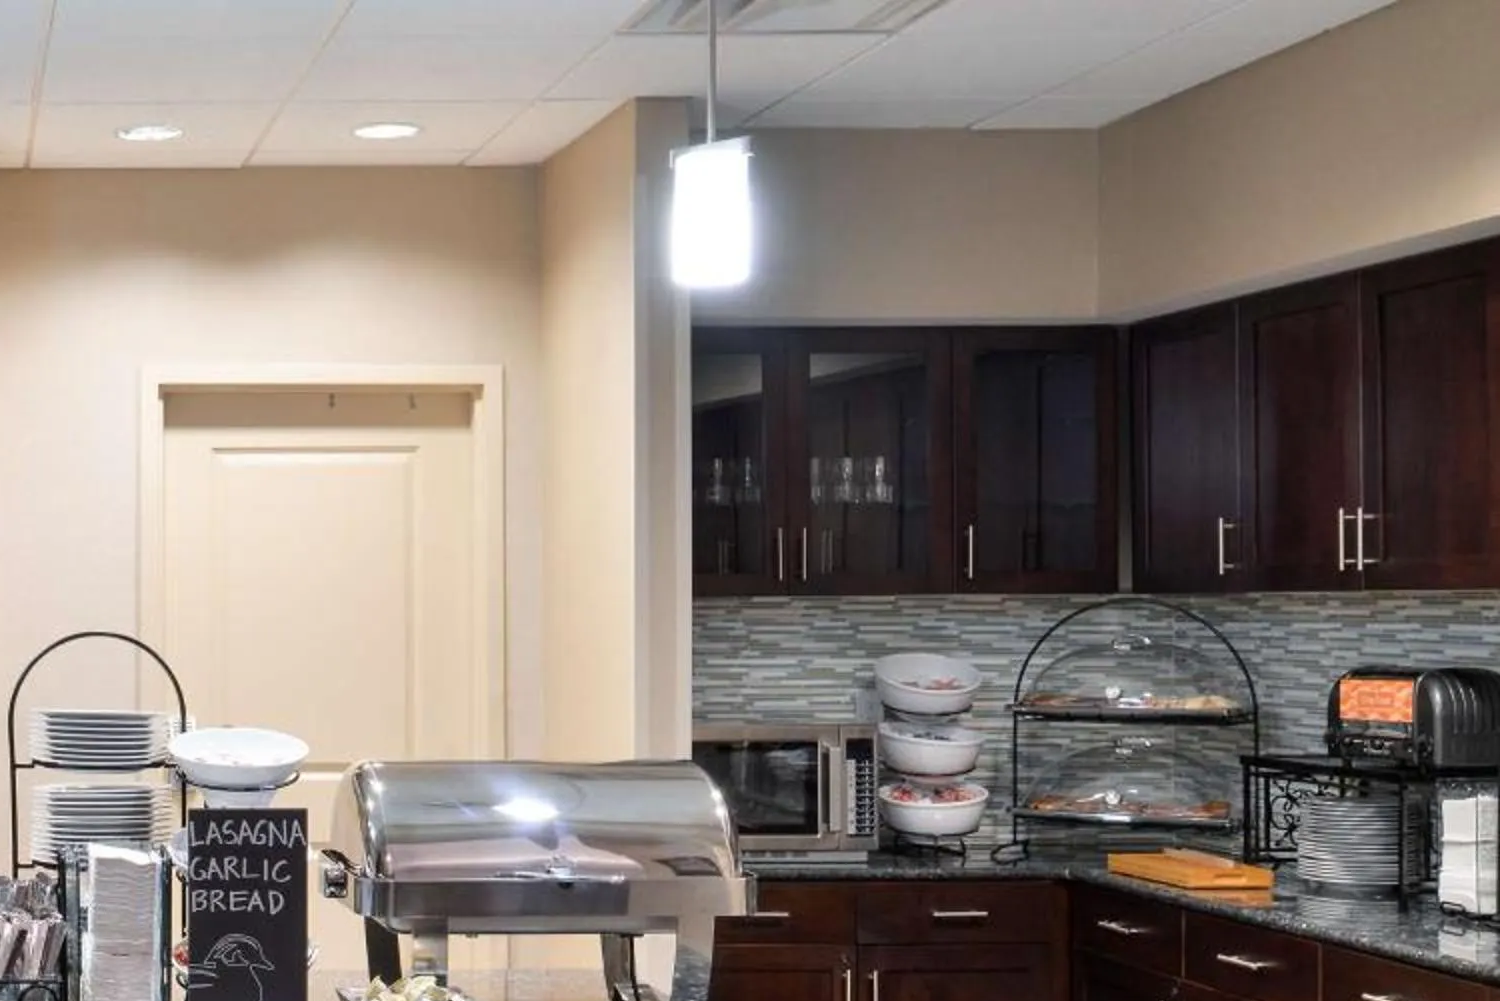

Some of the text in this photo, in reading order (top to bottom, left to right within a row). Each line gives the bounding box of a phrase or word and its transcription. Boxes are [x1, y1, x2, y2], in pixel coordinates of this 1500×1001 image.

[189, 819, 307, 848] LASAGNA
[190, 856, 292, 883] GARLIC
[192, 889, 285, 915] BREAD
